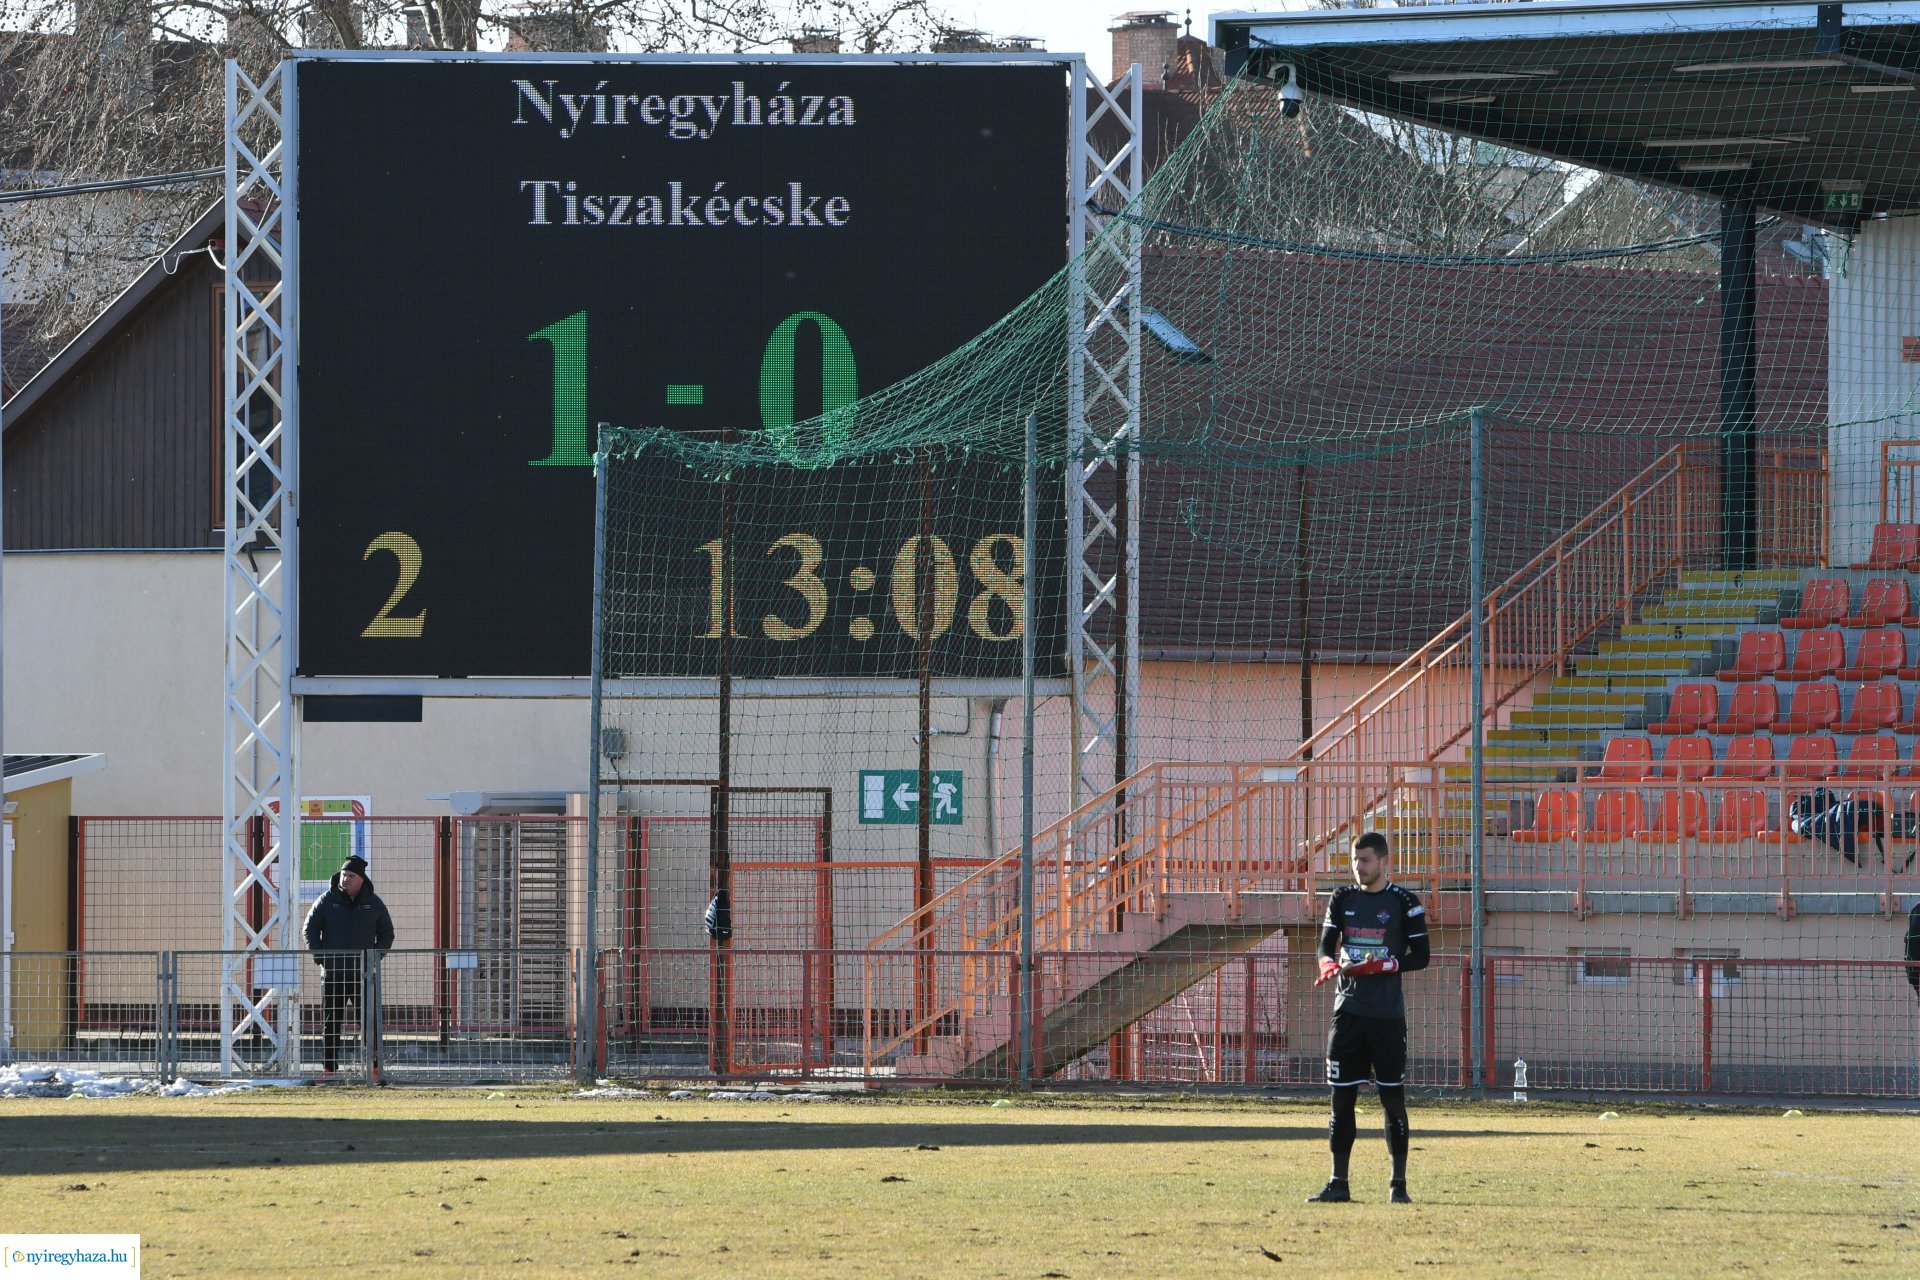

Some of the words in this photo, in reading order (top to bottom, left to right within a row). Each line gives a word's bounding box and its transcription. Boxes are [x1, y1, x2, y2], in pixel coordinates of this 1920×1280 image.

[511, 79, 857, 139] Nyíregyháza
[519, 180, 851, 226] Tiszakécske
[525, 309, 594, 466] 1
[759, 310, 858, 469] 0
[360, 530, 427, 638] 2
[693, 532, 1025, 641] 13:08
